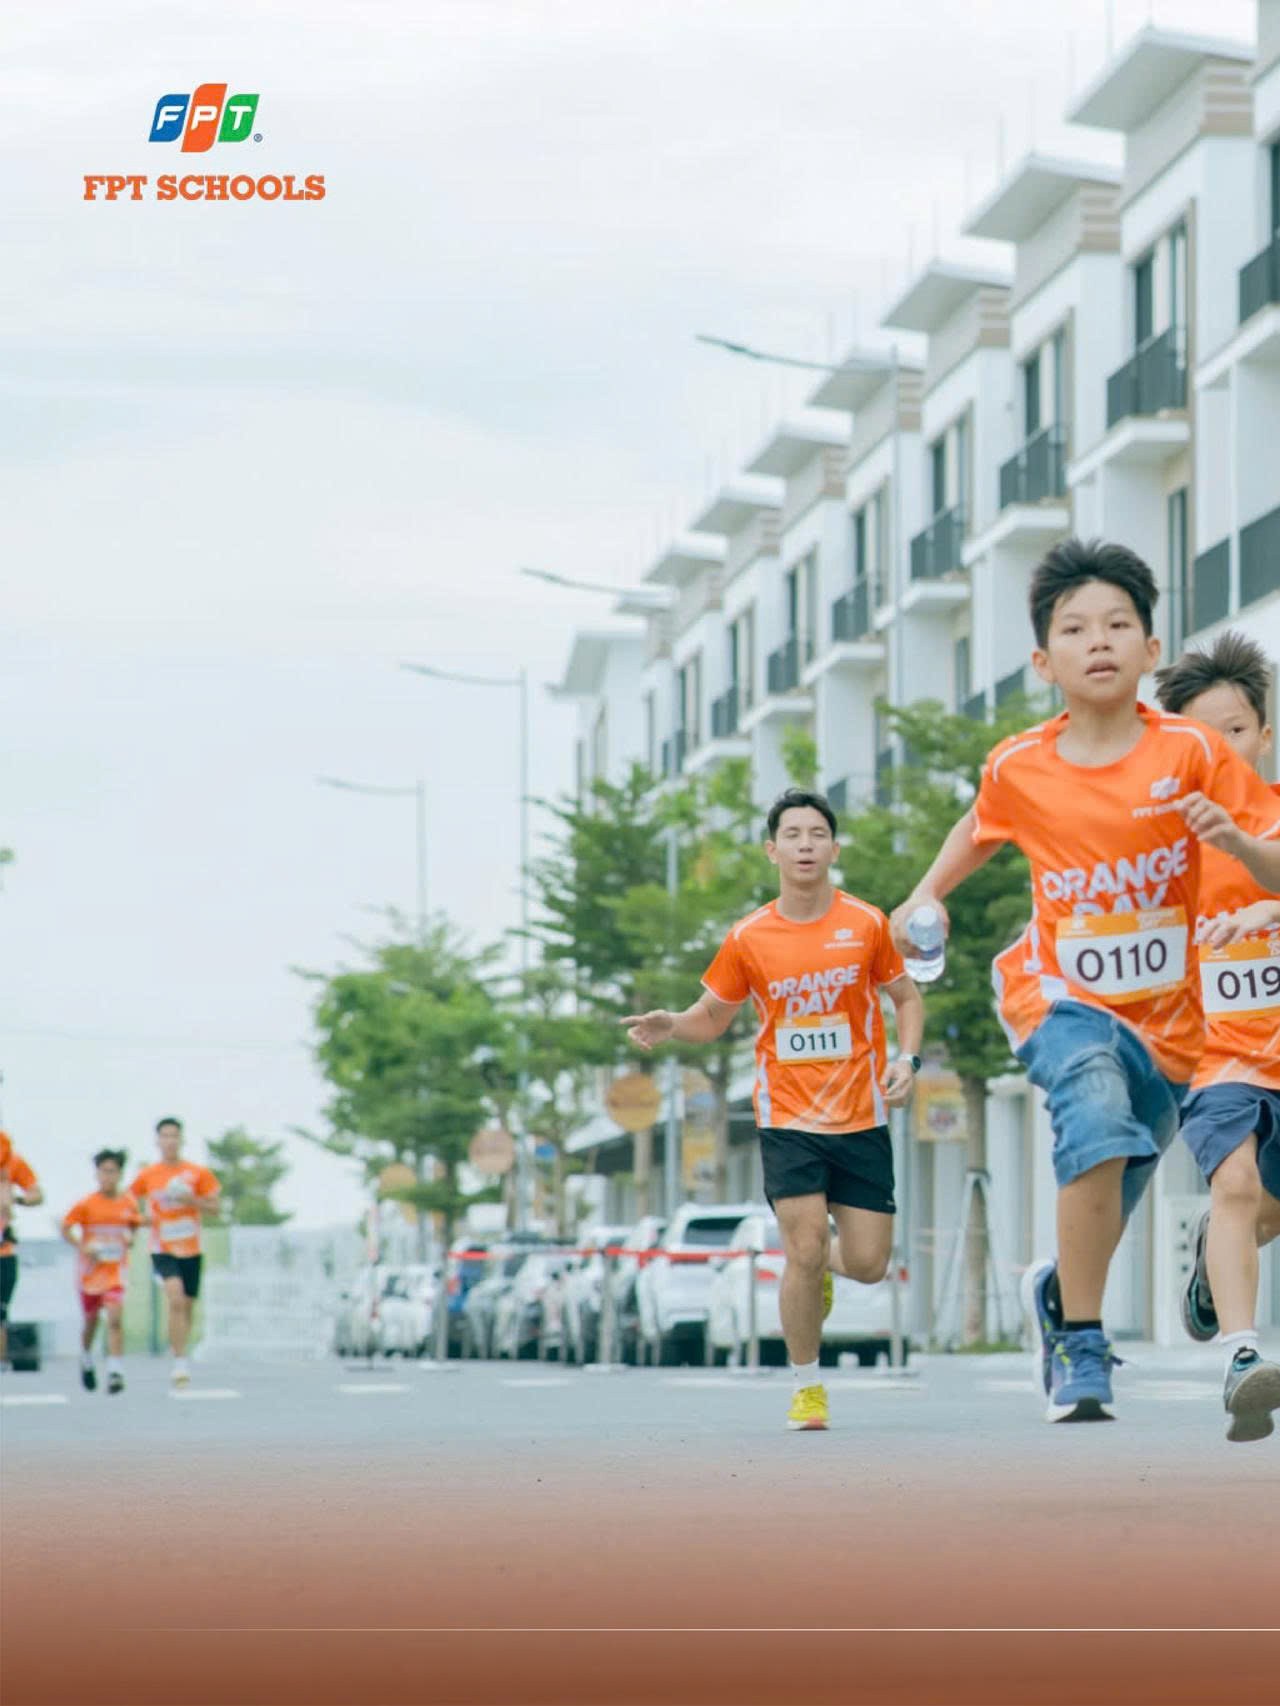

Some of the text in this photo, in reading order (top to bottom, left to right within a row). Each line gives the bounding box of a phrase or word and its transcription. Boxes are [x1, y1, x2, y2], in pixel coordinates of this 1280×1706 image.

[1041, 836, 1190, 902] ORANGE
[1076, 938, 1168, 982] 0110
[768, 963, 861, 1000] ORANGE
[785, 986, 844, 1017] DAY
[789, 1031, 838, 1052] 0111
